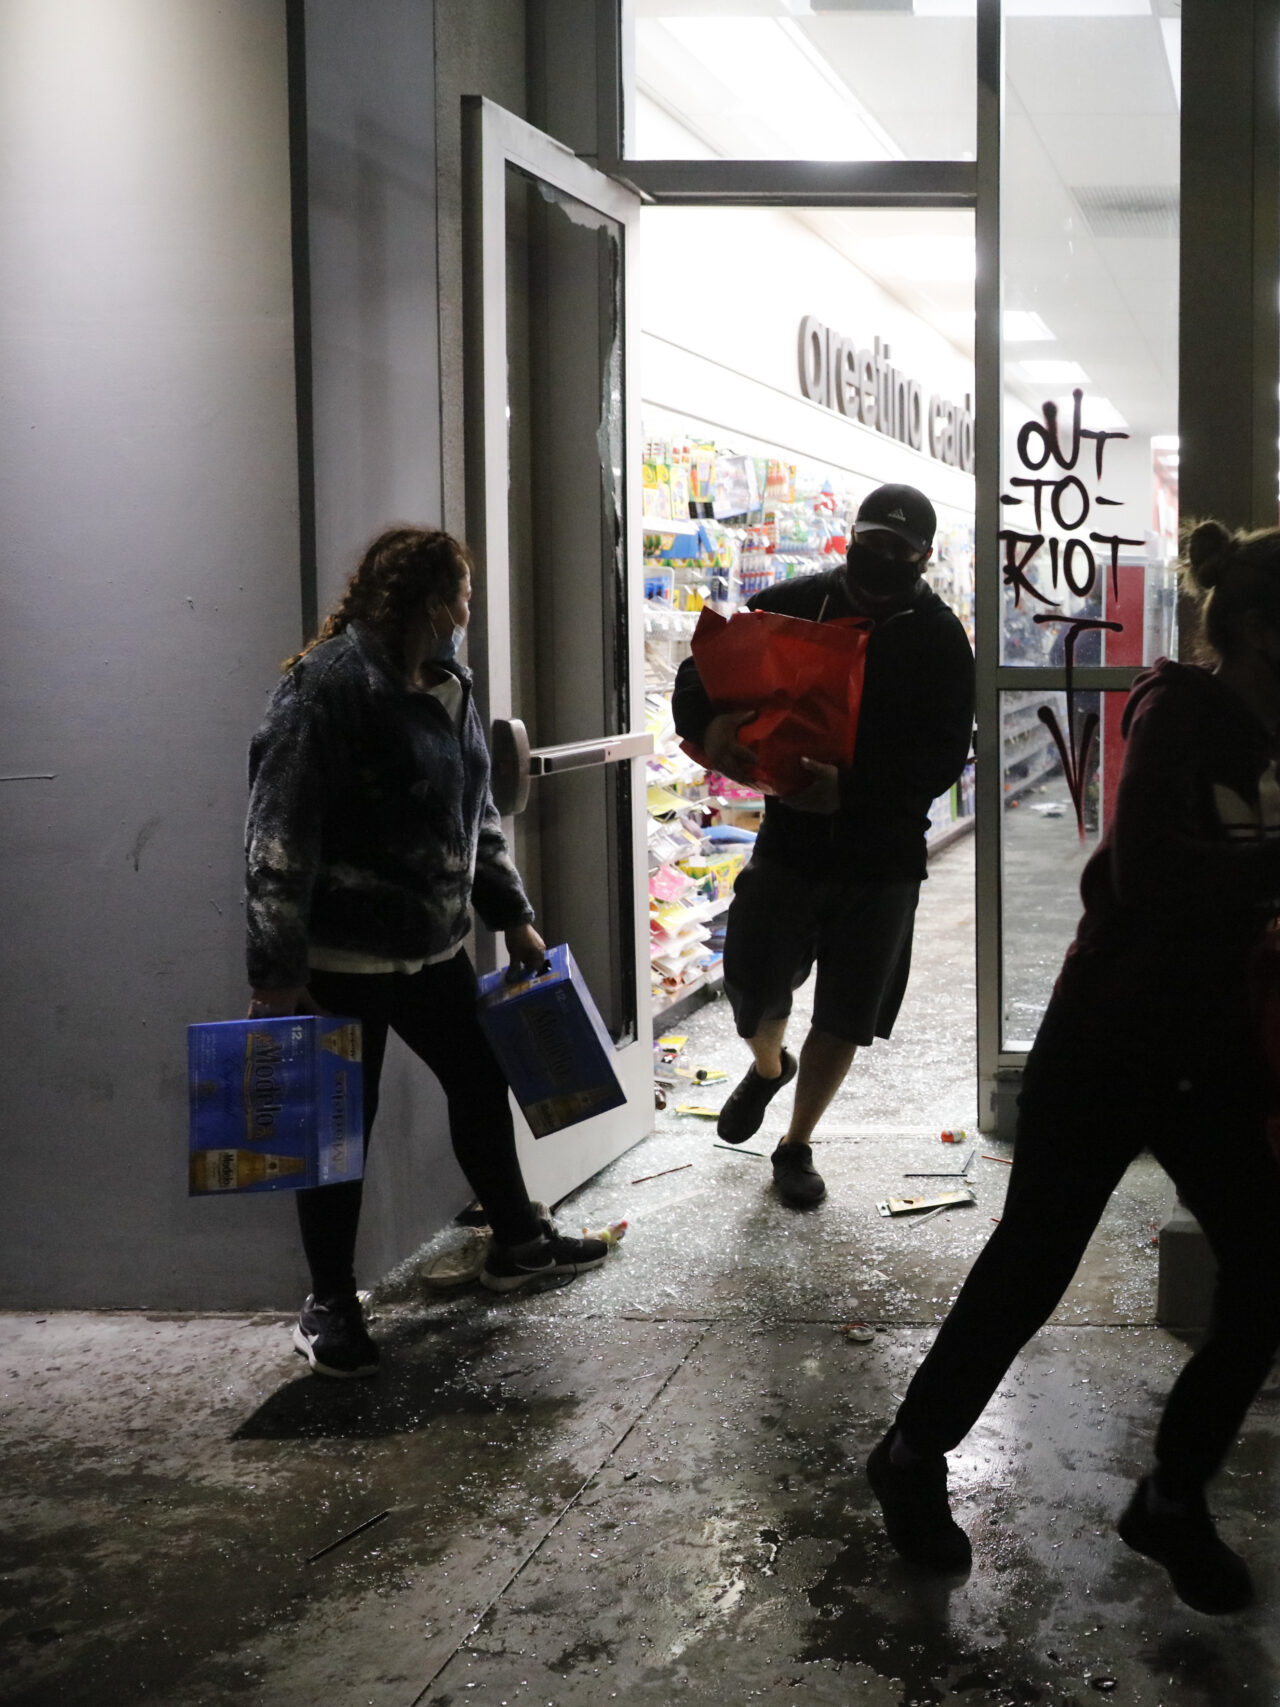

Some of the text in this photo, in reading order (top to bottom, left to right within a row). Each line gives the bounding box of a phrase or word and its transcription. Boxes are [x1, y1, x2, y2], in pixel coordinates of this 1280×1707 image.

[1017, 388, 1130, 481] OUT
[998, 530, 1146, 608] RIOT
[291, 1025, 303, 1041] 12
[255, 1044, 283, 1129] Modelo
[221, 1153, 235, 1186] Modelo
